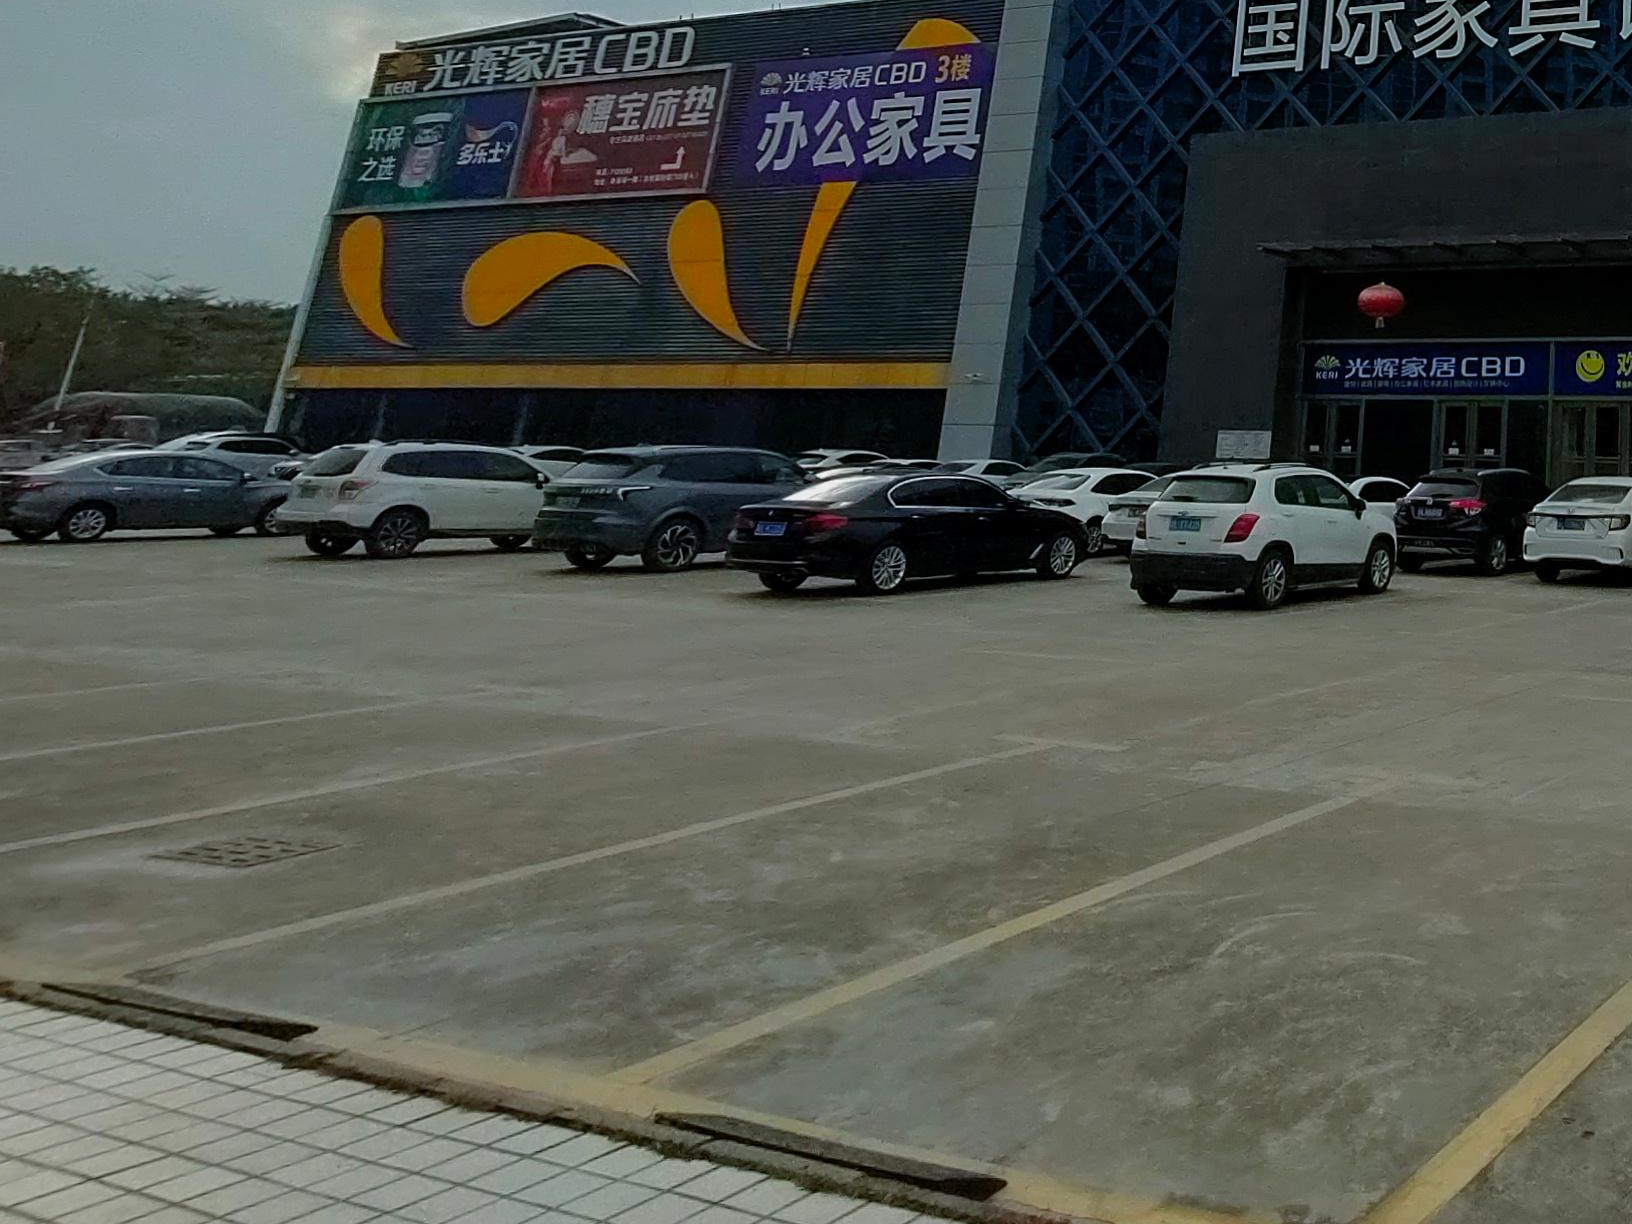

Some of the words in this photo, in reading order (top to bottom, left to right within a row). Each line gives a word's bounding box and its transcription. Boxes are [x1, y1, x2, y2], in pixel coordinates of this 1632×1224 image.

[423, 26, 696, 92] 光辉家居CBD
[783, 61, 927, 95] 光辉家居CBD
[934, 52, 973, 84] 3楼
[384, 80, 418, 97] KERI
[575, 84, 718, 136] 穗宝床垫
[366, 126, 406, 152] 环保
[755, 87, 982, 173] 办公家具
[456, 140, 506, 166] 多乐士
[356, 156, 397, 182] 之选
[1315, 370, 1340, 381] KERI
[1344, 356, 1527, 379] 光辉家居CBD
